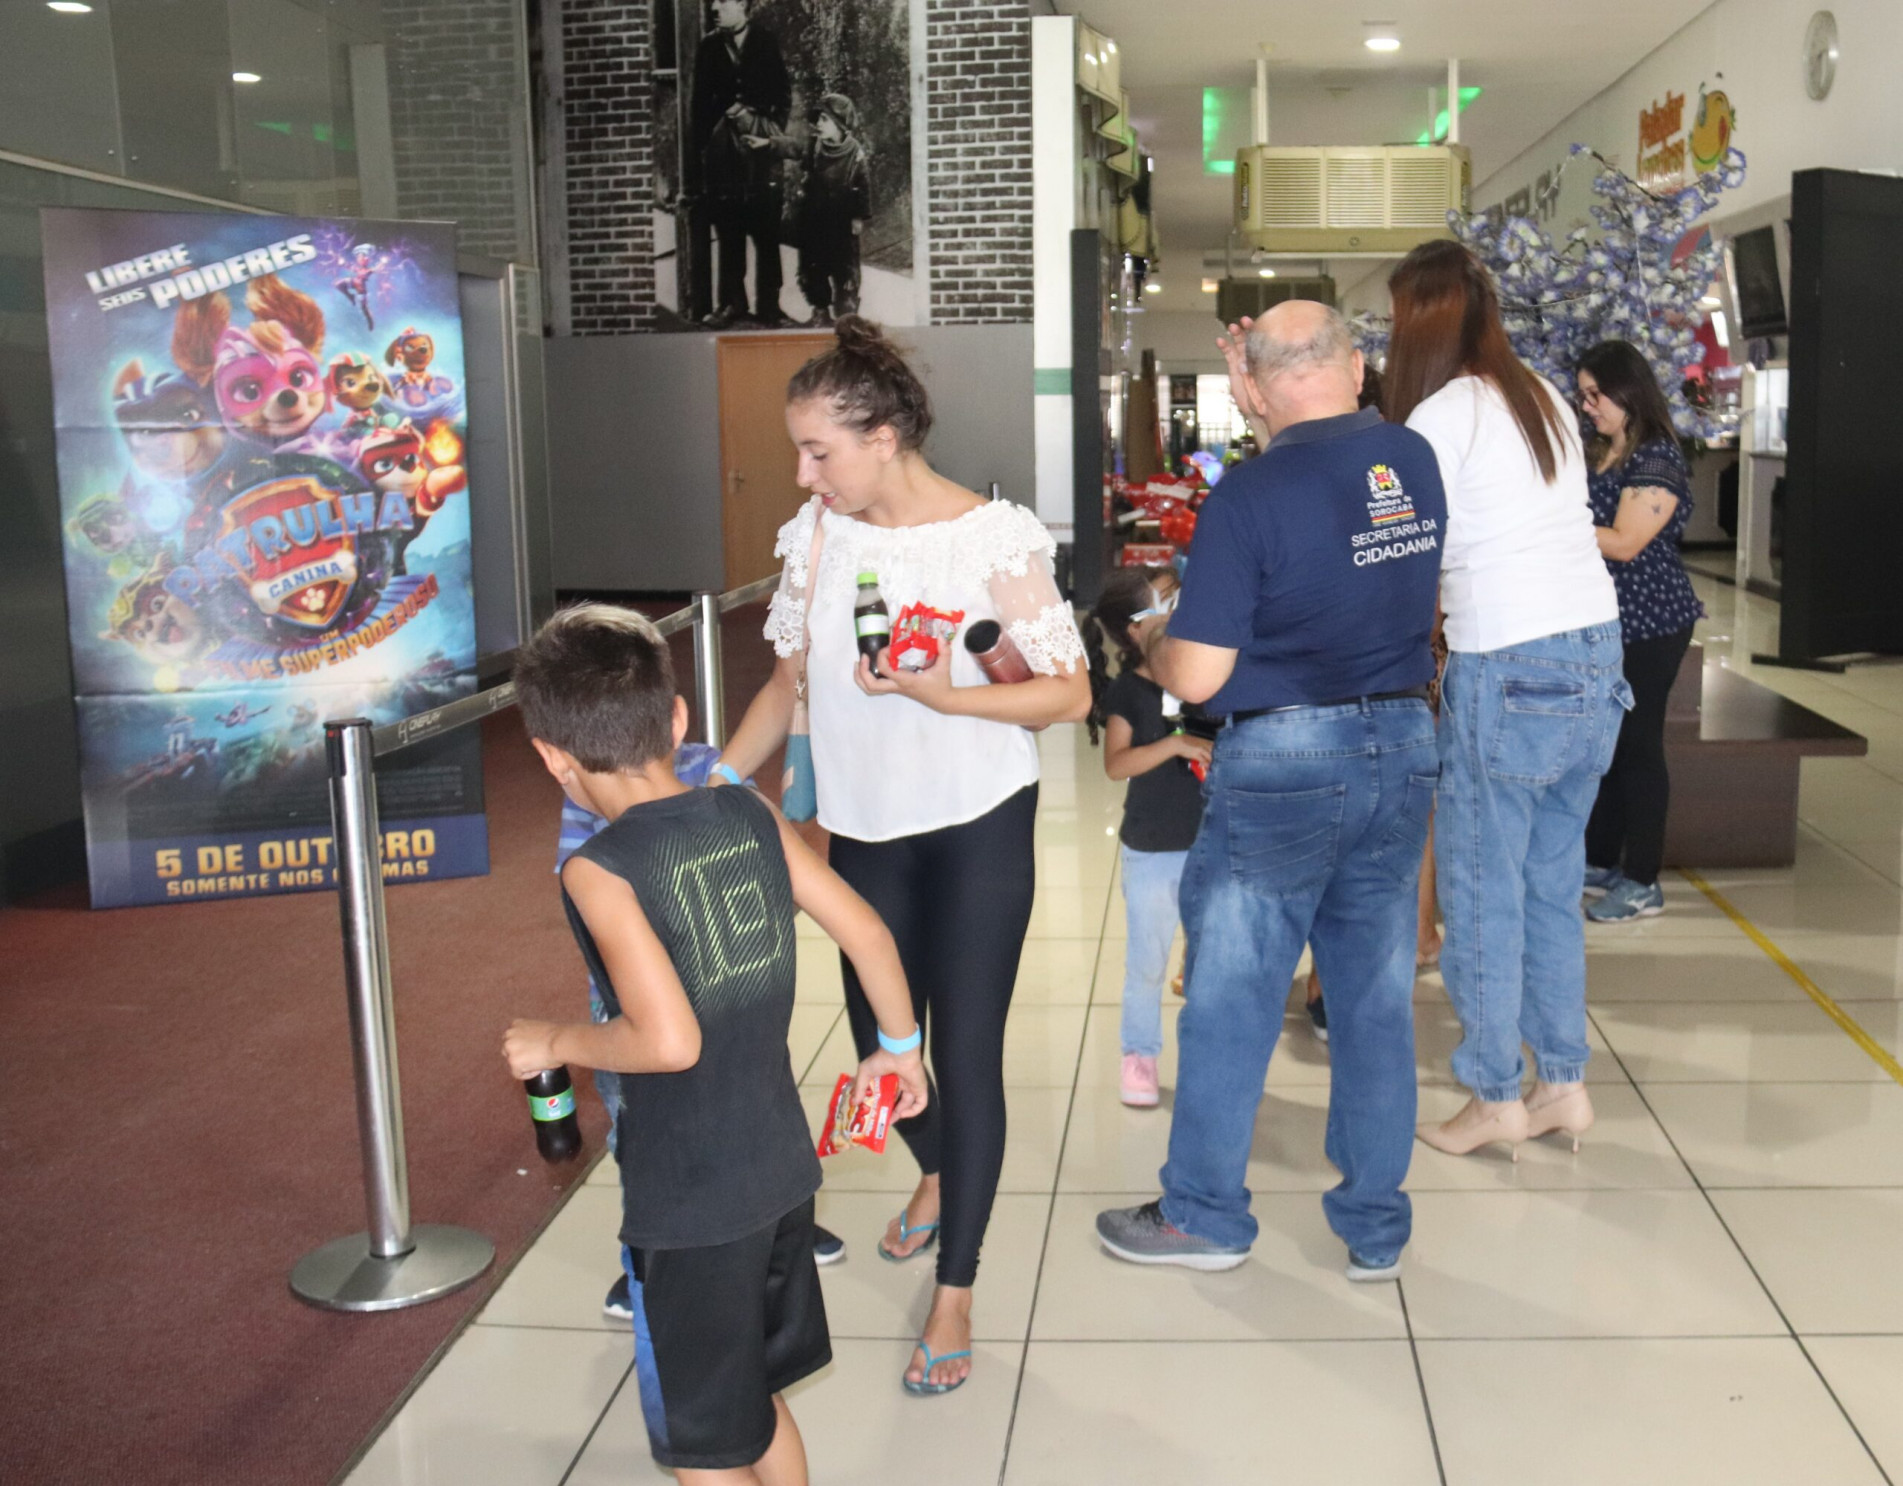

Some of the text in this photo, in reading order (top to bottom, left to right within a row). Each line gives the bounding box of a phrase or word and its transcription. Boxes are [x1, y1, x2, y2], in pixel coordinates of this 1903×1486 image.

[85, 243, 192, 294] LIBERE
[98, 233, 318, 311] SEUS PODERES
[1370, 503, 1413, 517] SOROCABA
[1351, 522, 1420, 547] SECRETARIA
[1422, 518, 1437, 533] DA
[1353, 535, 1437, 567] CIDADANIA
[268, 561, 343, 599] CANINA
[281, 572, 440, 677] SUPERPODEROSO
[156, 829, 436, 878] 5 DE OUTRO
[166, 872, 270, 896] SOMENTE
[278, 868, 324, 887] NOS
